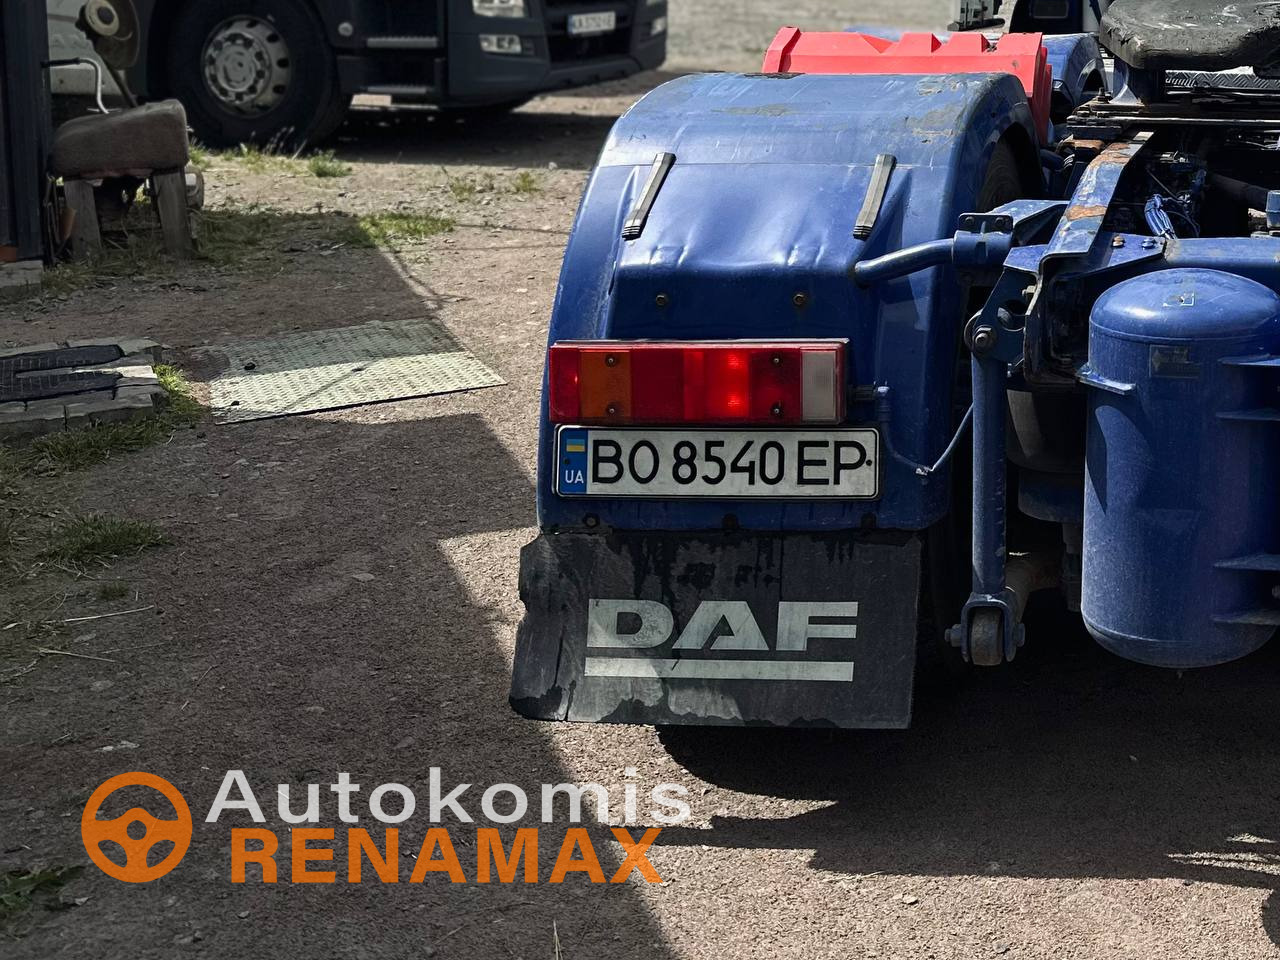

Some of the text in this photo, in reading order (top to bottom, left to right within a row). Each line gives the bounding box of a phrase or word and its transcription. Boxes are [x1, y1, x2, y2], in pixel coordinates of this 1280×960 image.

[564, 469, 584, 484] UA
[591, 440, 867, 486] BO 8540 EP
[586, 598, 859, 652] DAF
